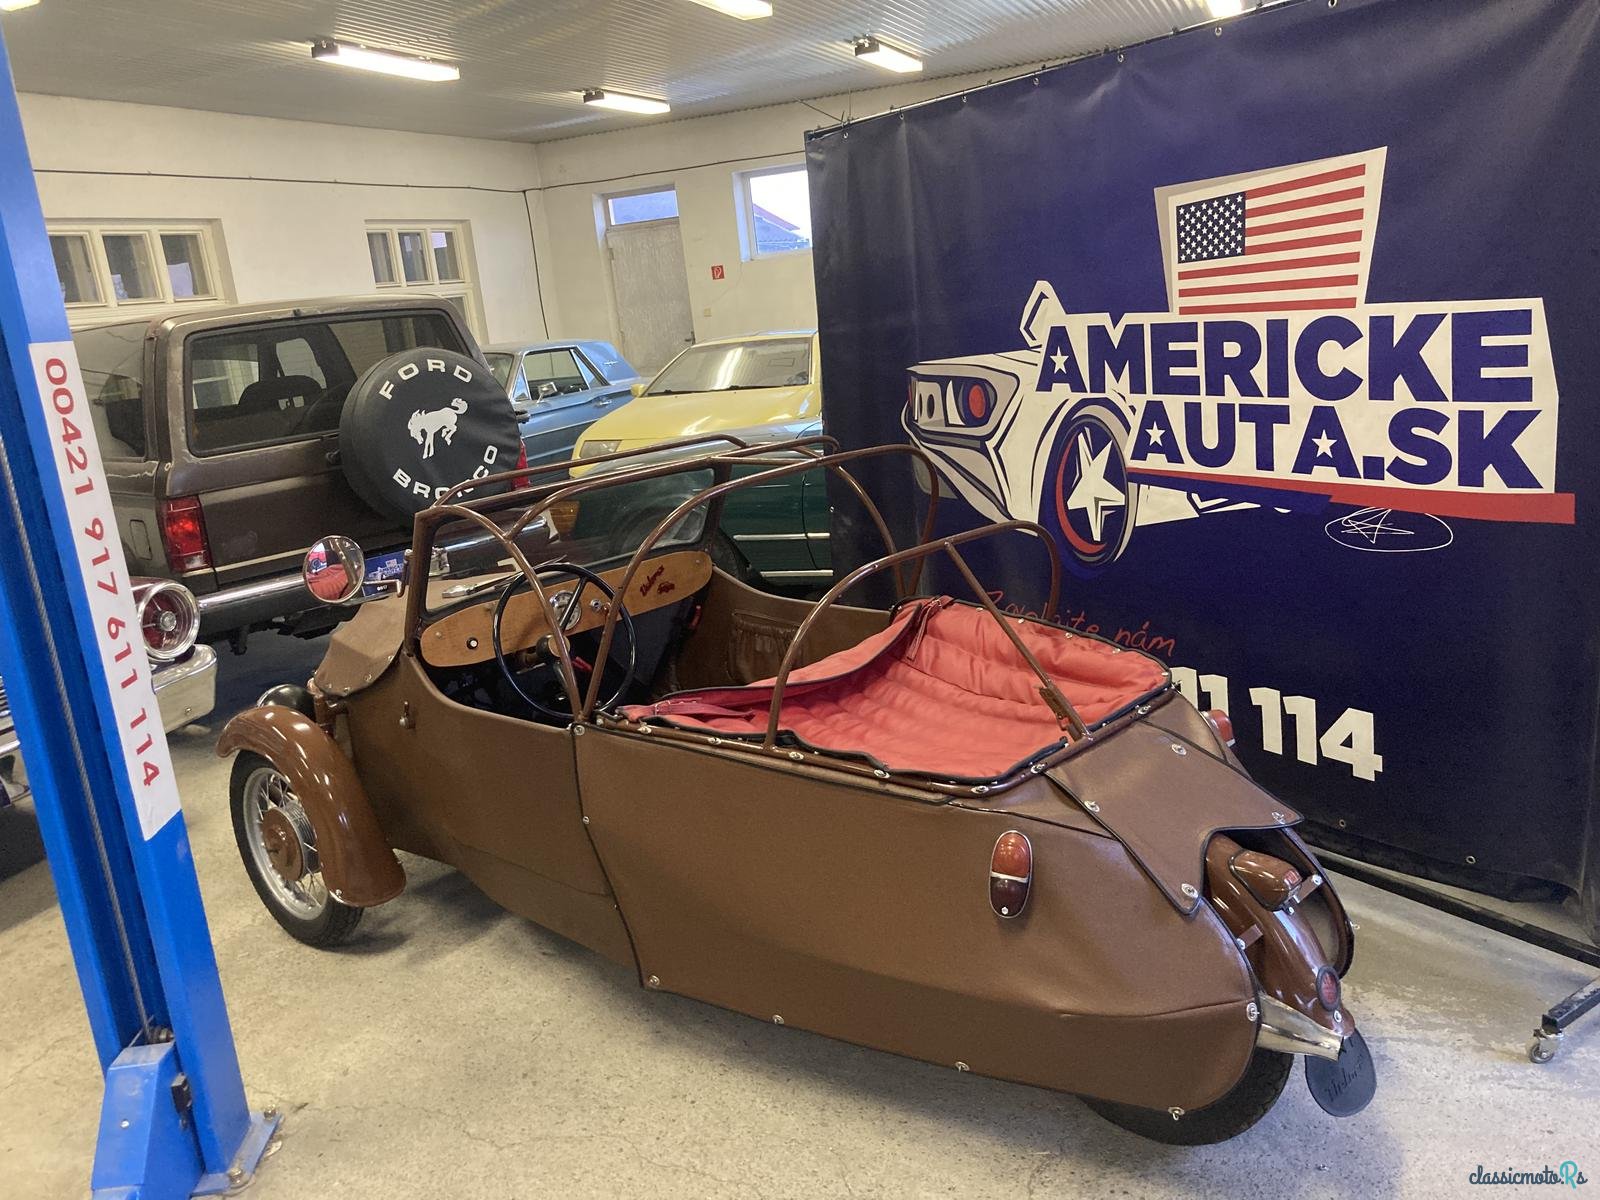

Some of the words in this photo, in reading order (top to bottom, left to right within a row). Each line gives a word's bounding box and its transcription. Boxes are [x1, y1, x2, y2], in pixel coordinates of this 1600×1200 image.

[378, 358, 473, 400] FORD
[1036, 308, 1533, 403] AMERICKE
[1130, 400, 1544, 489] AUTA.SK
[45, 357, 94, 496] 00421
[84, 517, 119, 596] 917
[107, 616, 138, 689] 611
[130, 707, 160, 787] 114
[1113, 621, 1176, 657] nám
[1248, 686, 1383, 782] 114
